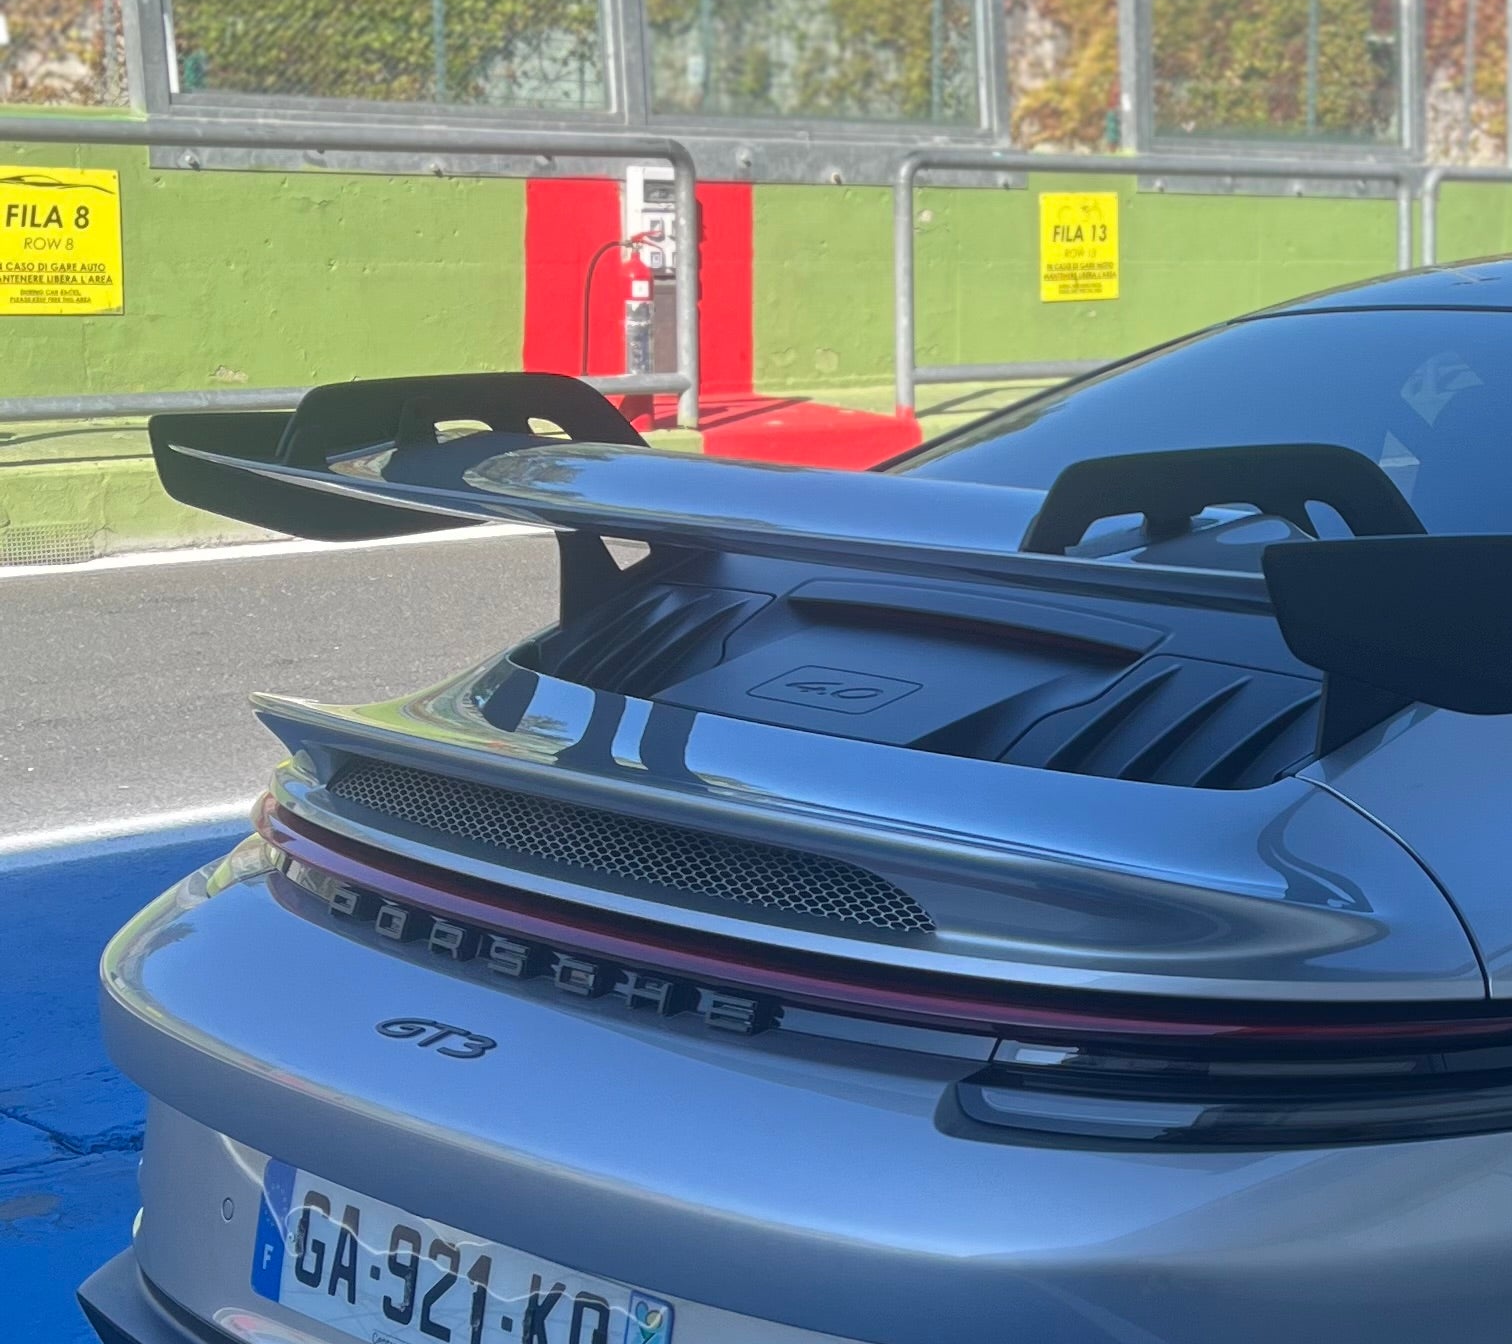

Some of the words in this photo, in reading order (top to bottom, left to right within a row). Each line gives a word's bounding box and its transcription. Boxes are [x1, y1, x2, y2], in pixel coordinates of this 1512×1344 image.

[6, 204, 63, 228] FILA
[74, 205, 90, 229] 8
[1053, 224, 1084, 242] FILA
[1091, 224, 1108, 242] 13
[24, 237, 61, 250] ROW
[65, 238, 74, 251] 8
[5, 261, 35, 272] CASO
[38, 262, 47, 272] DI
[51, 262, 77, 272] GARE
[80, 263, 106, 273] AUTO
[46, 275, 78, 285] LIBERA
[329, 883, 760, 1034] PORSCHE
[375, 1017, 498, 1059] GT3
[262, 1243, 274, 1270] F
